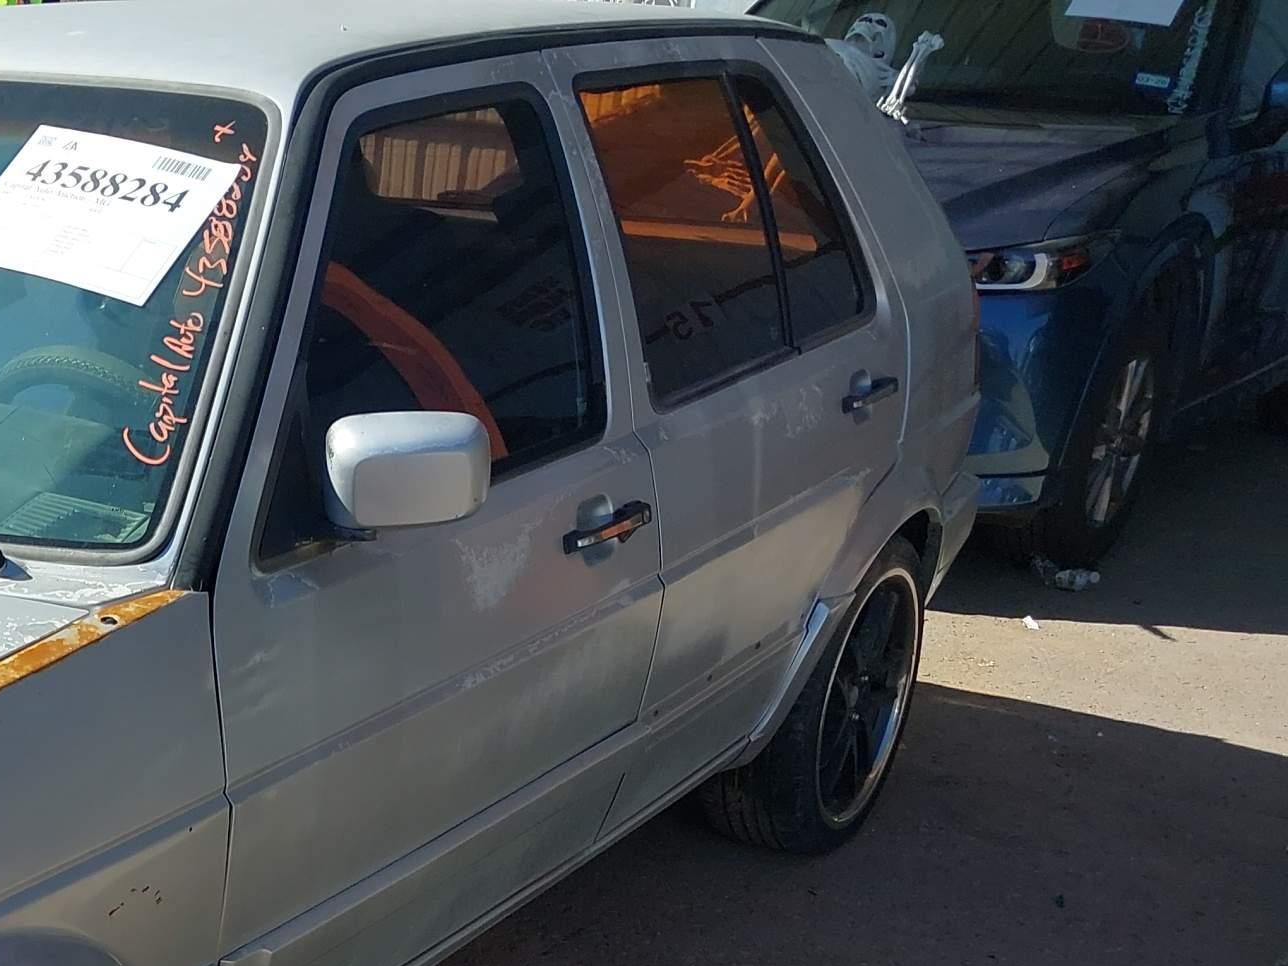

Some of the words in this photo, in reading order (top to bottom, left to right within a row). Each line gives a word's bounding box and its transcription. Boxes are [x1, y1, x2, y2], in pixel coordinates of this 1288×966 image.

[25, 159, 190, 213] 43588284
[123, 354, 190, 465] Capital
[163, 312, 204, 358] Auto
